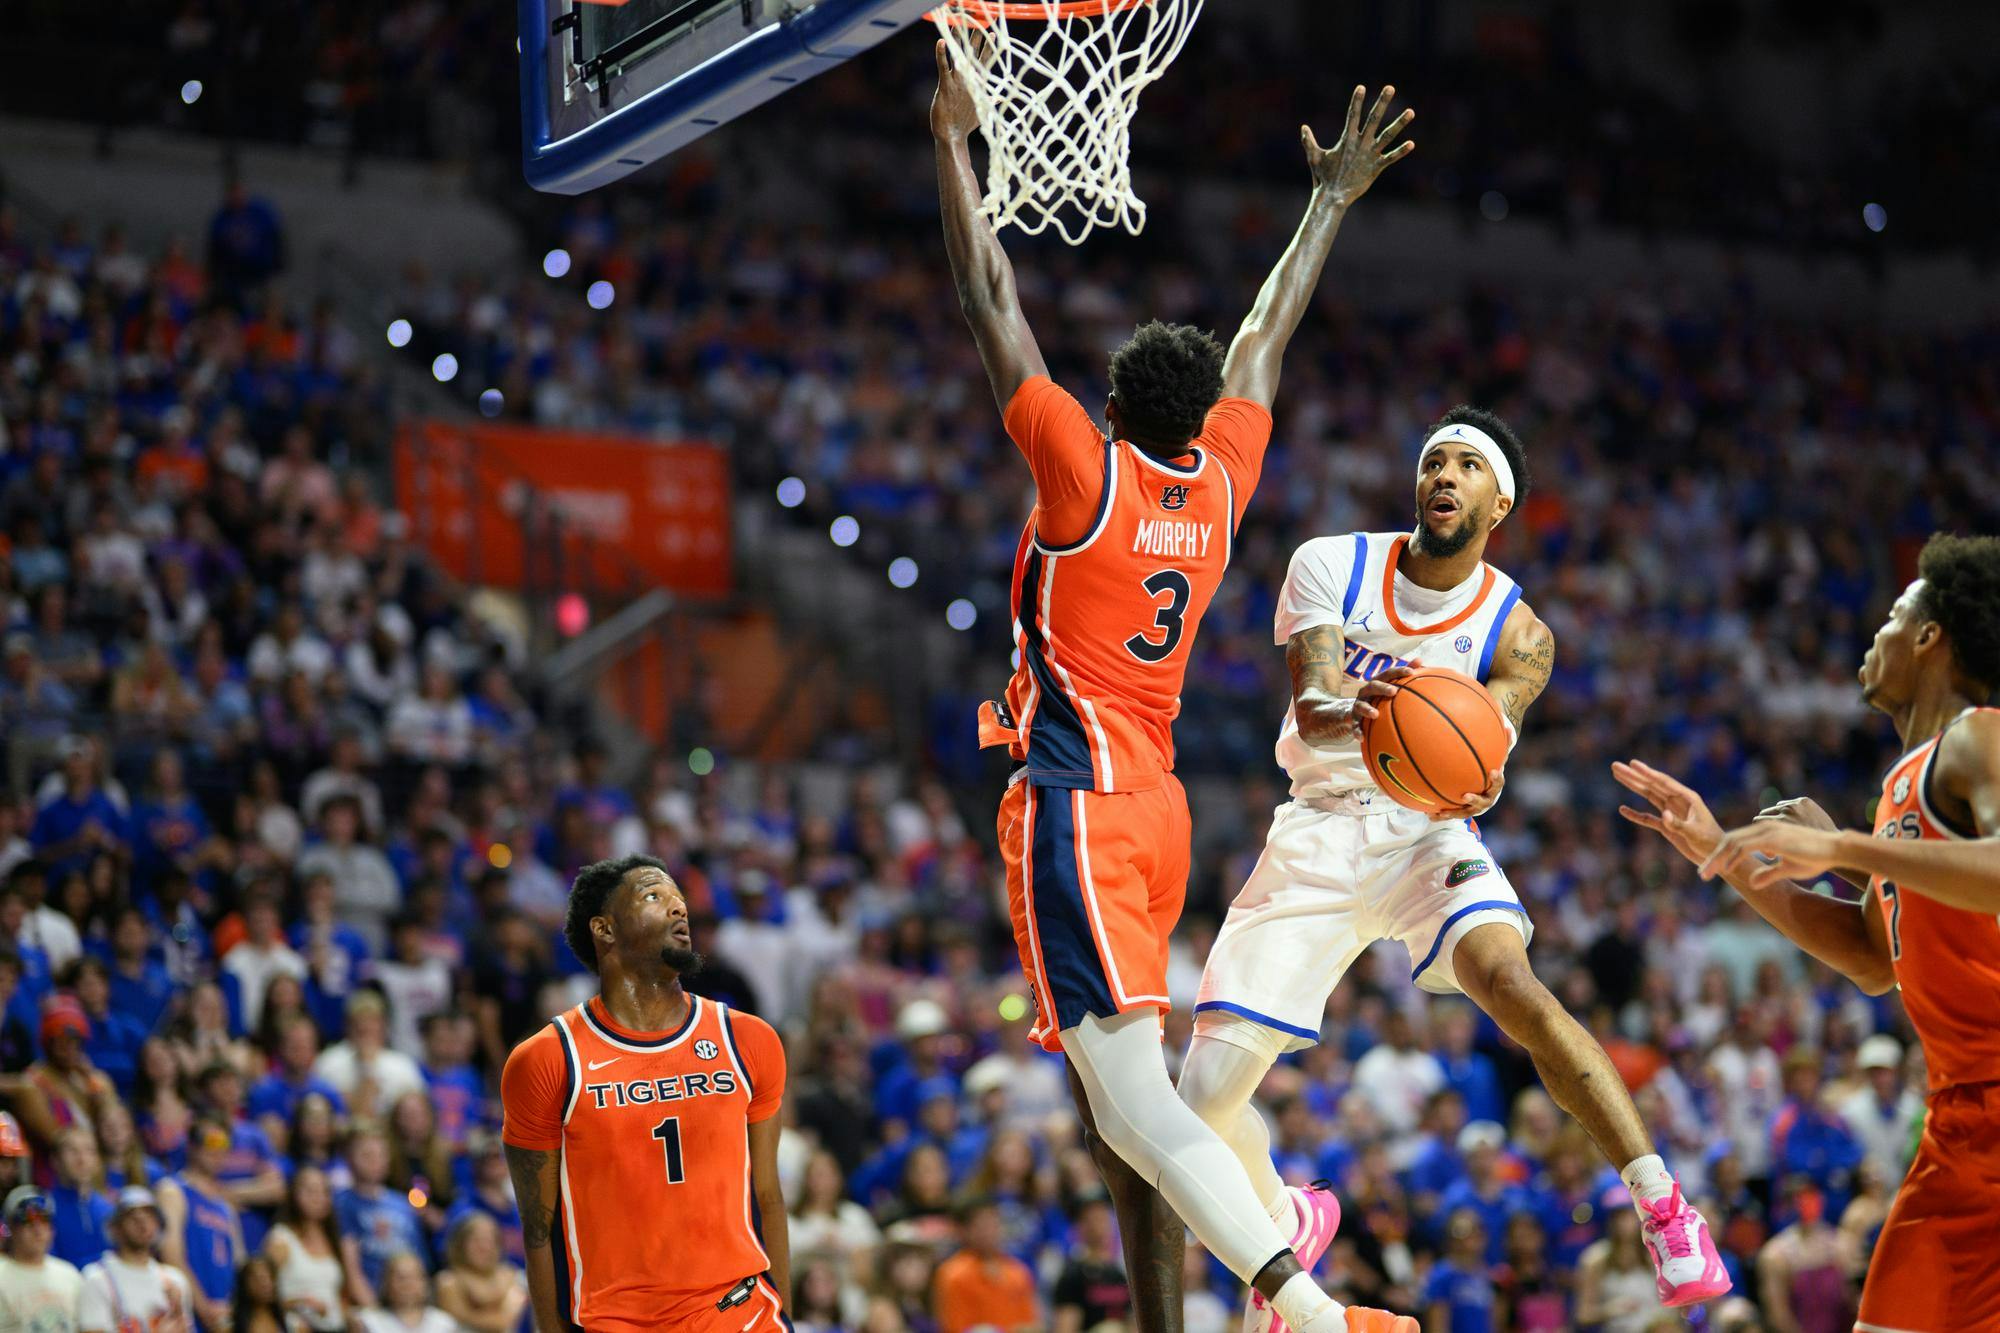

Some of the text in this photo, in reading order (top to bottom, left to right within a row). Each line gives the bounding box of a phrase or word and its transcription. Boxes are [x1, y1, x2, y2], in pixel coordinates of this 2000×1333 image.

[1132, 518, 1213, 557] MURPHY
[1123, 568, 1192, 664] 3
[694, 1039, 719, 1060] SEC
[585, 1070, 738, 1109] TIGERS
[651, 1115, 686, 1185] 1
